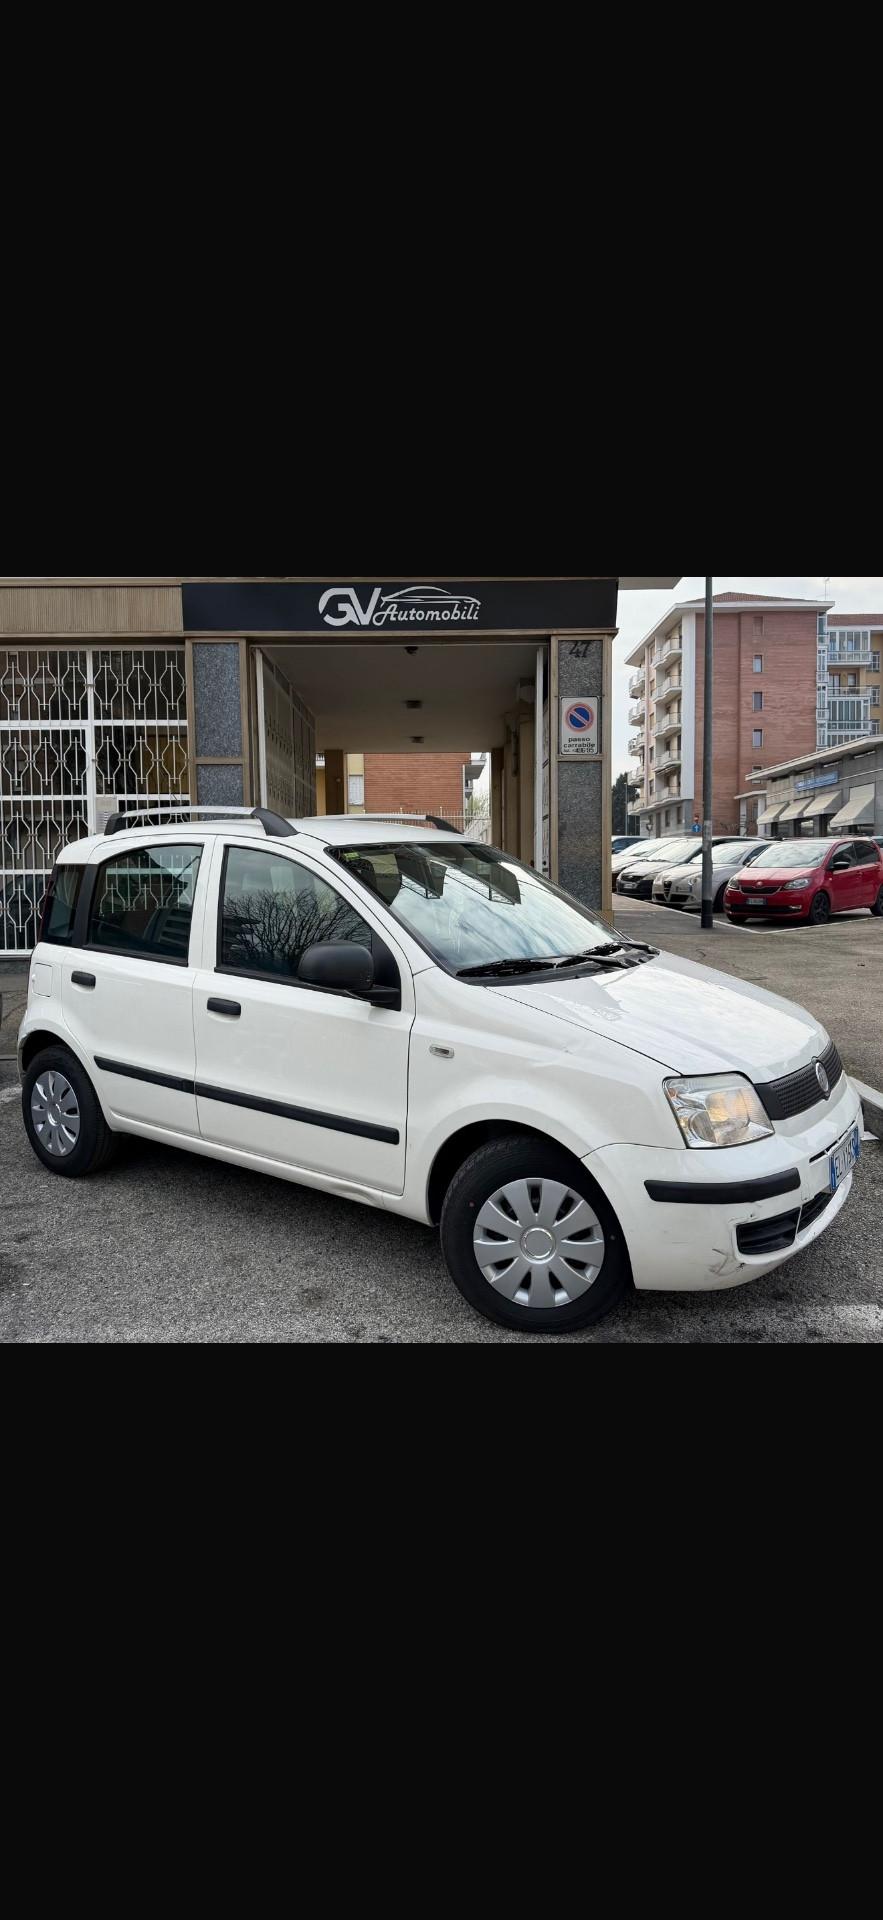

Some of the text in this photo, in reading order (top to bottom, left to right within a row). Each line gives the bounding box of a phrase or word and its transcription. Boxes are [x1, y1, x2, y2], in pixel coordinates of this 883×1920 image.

[318, 587, 480, 627] GV Automobili
[569, 641, 591, 658] 47
